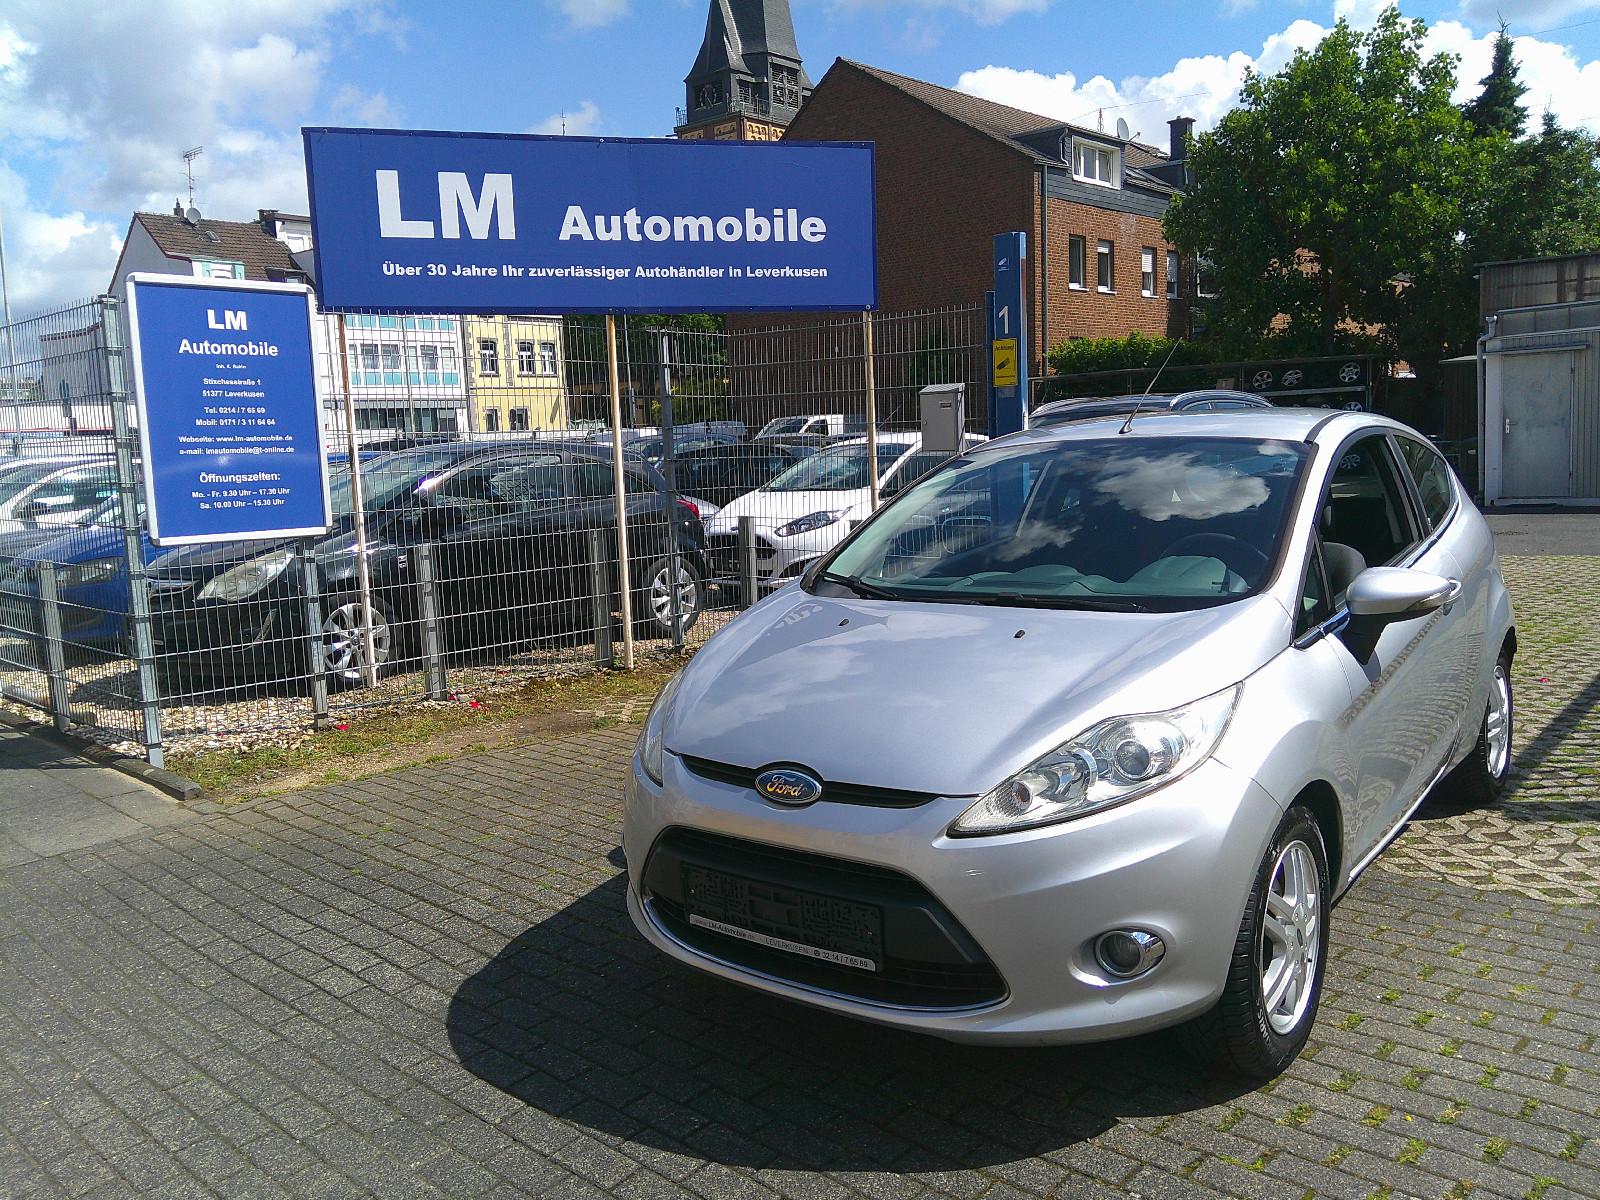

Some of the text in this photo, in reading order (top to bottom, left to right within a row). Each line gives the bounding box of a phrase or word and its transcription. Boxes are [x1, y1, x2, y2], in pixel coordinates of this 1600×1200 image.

[376, 170, 826, 242] LM Automobile
[383, 261, 827, 280] Über 30 Jahre Ihr zuverlässiger Autohändler in Leverkusen
[208, 310, 247, 330] LM
[998, 306, 1009, 334] 1
[179, 339, 278, 356] Automobile
[202, 389, 265, 398] 51377 Leverkusen
[203, 406, 218, 414] Tel.
[218, 406, 237, 414] 0214
[195, 418, 218, 426] Mobil:
[219, 418, 236, 426] 0171
[241, 418, 247, 426] 3
[247, 418, 255, 426] 11
[215, 434, 293, 442] www.lm-automobile.de
[179, 446, 295, 455] e-mail: lmautomobile@t-online.de
[199, 471, 281, 484] Öffnungszeiten:
[211, 490, 222, 498] Fr.
[222, 489, 238, 497] 9.30
[238, 489, 252, 497] Uhr
[258, 487, 277, 496] 17.30
[277, 487, 290, 495] Uhr
[199, 502, 212, 510] Sa.
[213, 500, 232, 509] 10.00
[232, 500, 247, 508] Uhr
[253, 498, 271, 507] 15.30
[272, 498, 285, 506] Uhr
[767, 775, 802, 796] Ford
